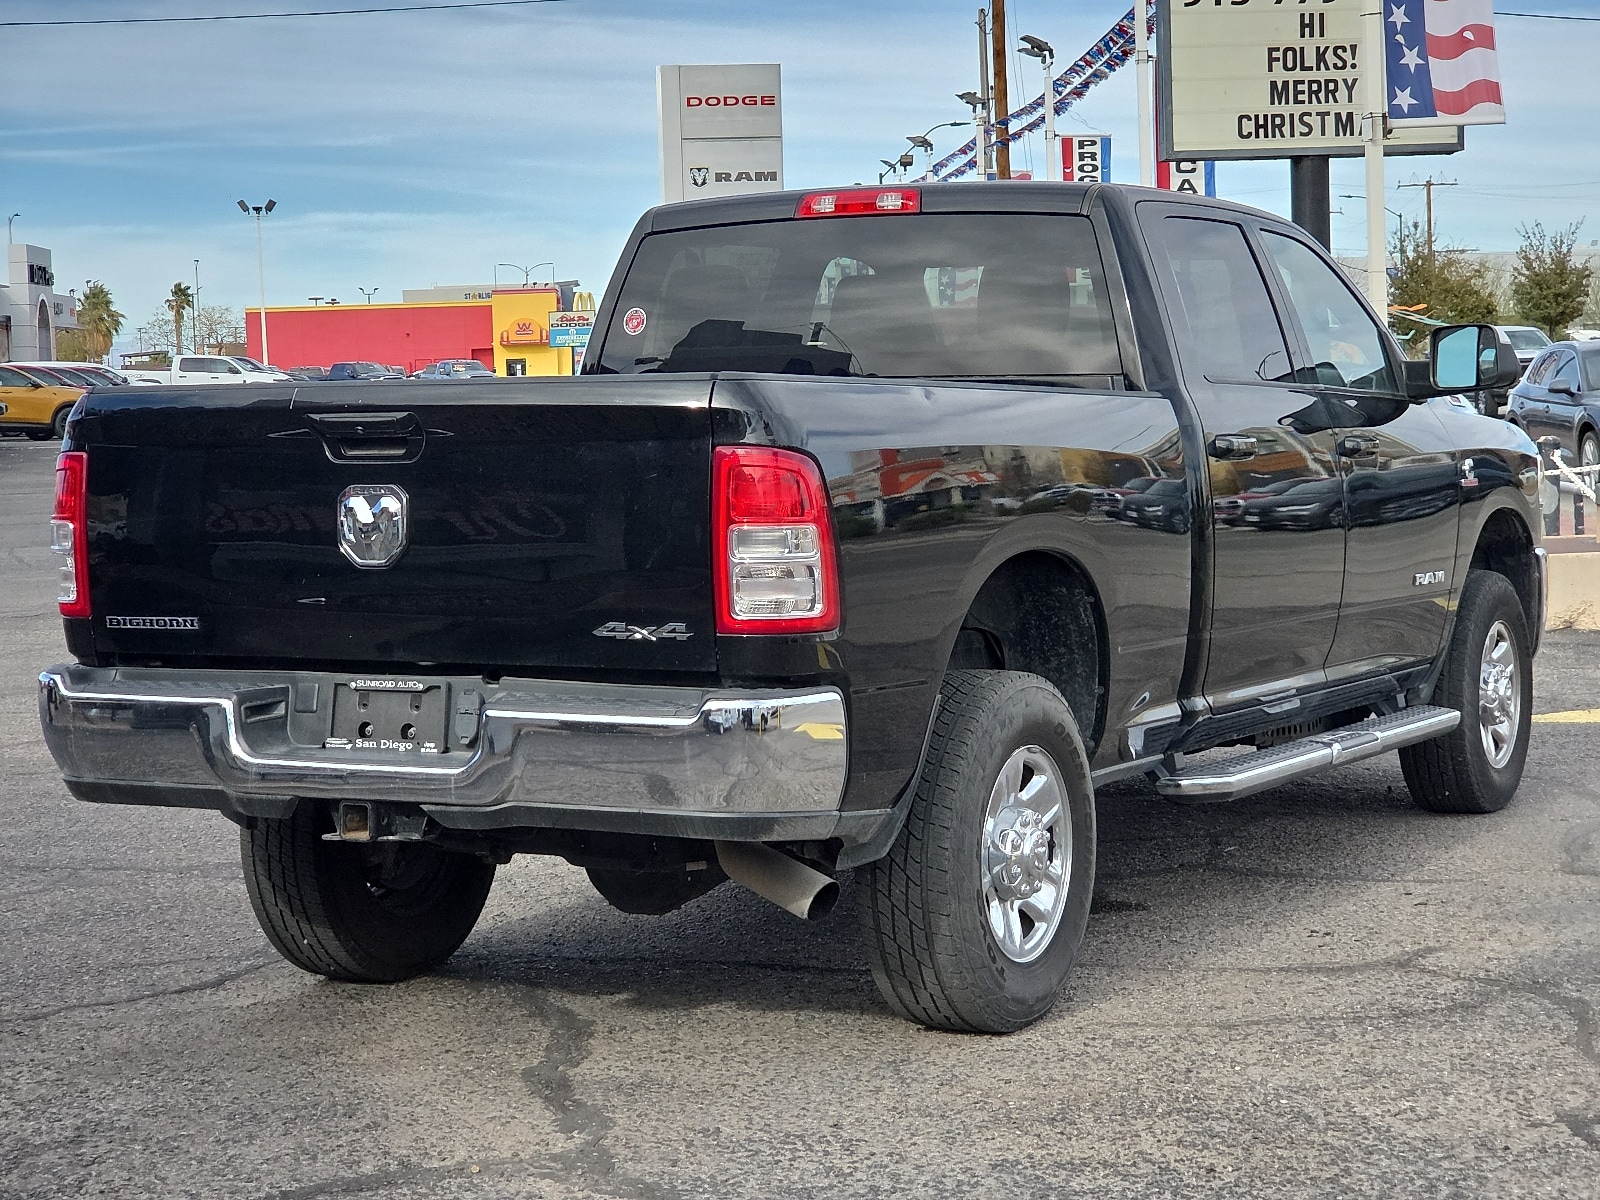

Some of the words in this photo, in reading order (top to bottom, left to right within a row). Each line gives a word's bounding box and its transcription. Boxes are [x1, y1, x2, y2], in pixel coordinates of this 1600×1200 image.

[1300, 12, 1325, 39] HI
[1267, 44, 1358, 72] FOLKS!
[1269, 78, 1359, 105] MERRY
[686, 95, 776, 107] DODGE
[714, 171, 778, 182] RAM
[1413, 570, 1445, 586] RAM
[105, 616, 200, 630] BIGHORN
[356, 679, 395, 688] SUNROAD
[397, 680, 419, 688] AUTO
[355, 738, 377, 748] San
[380, 739, 413, 752] Diego
